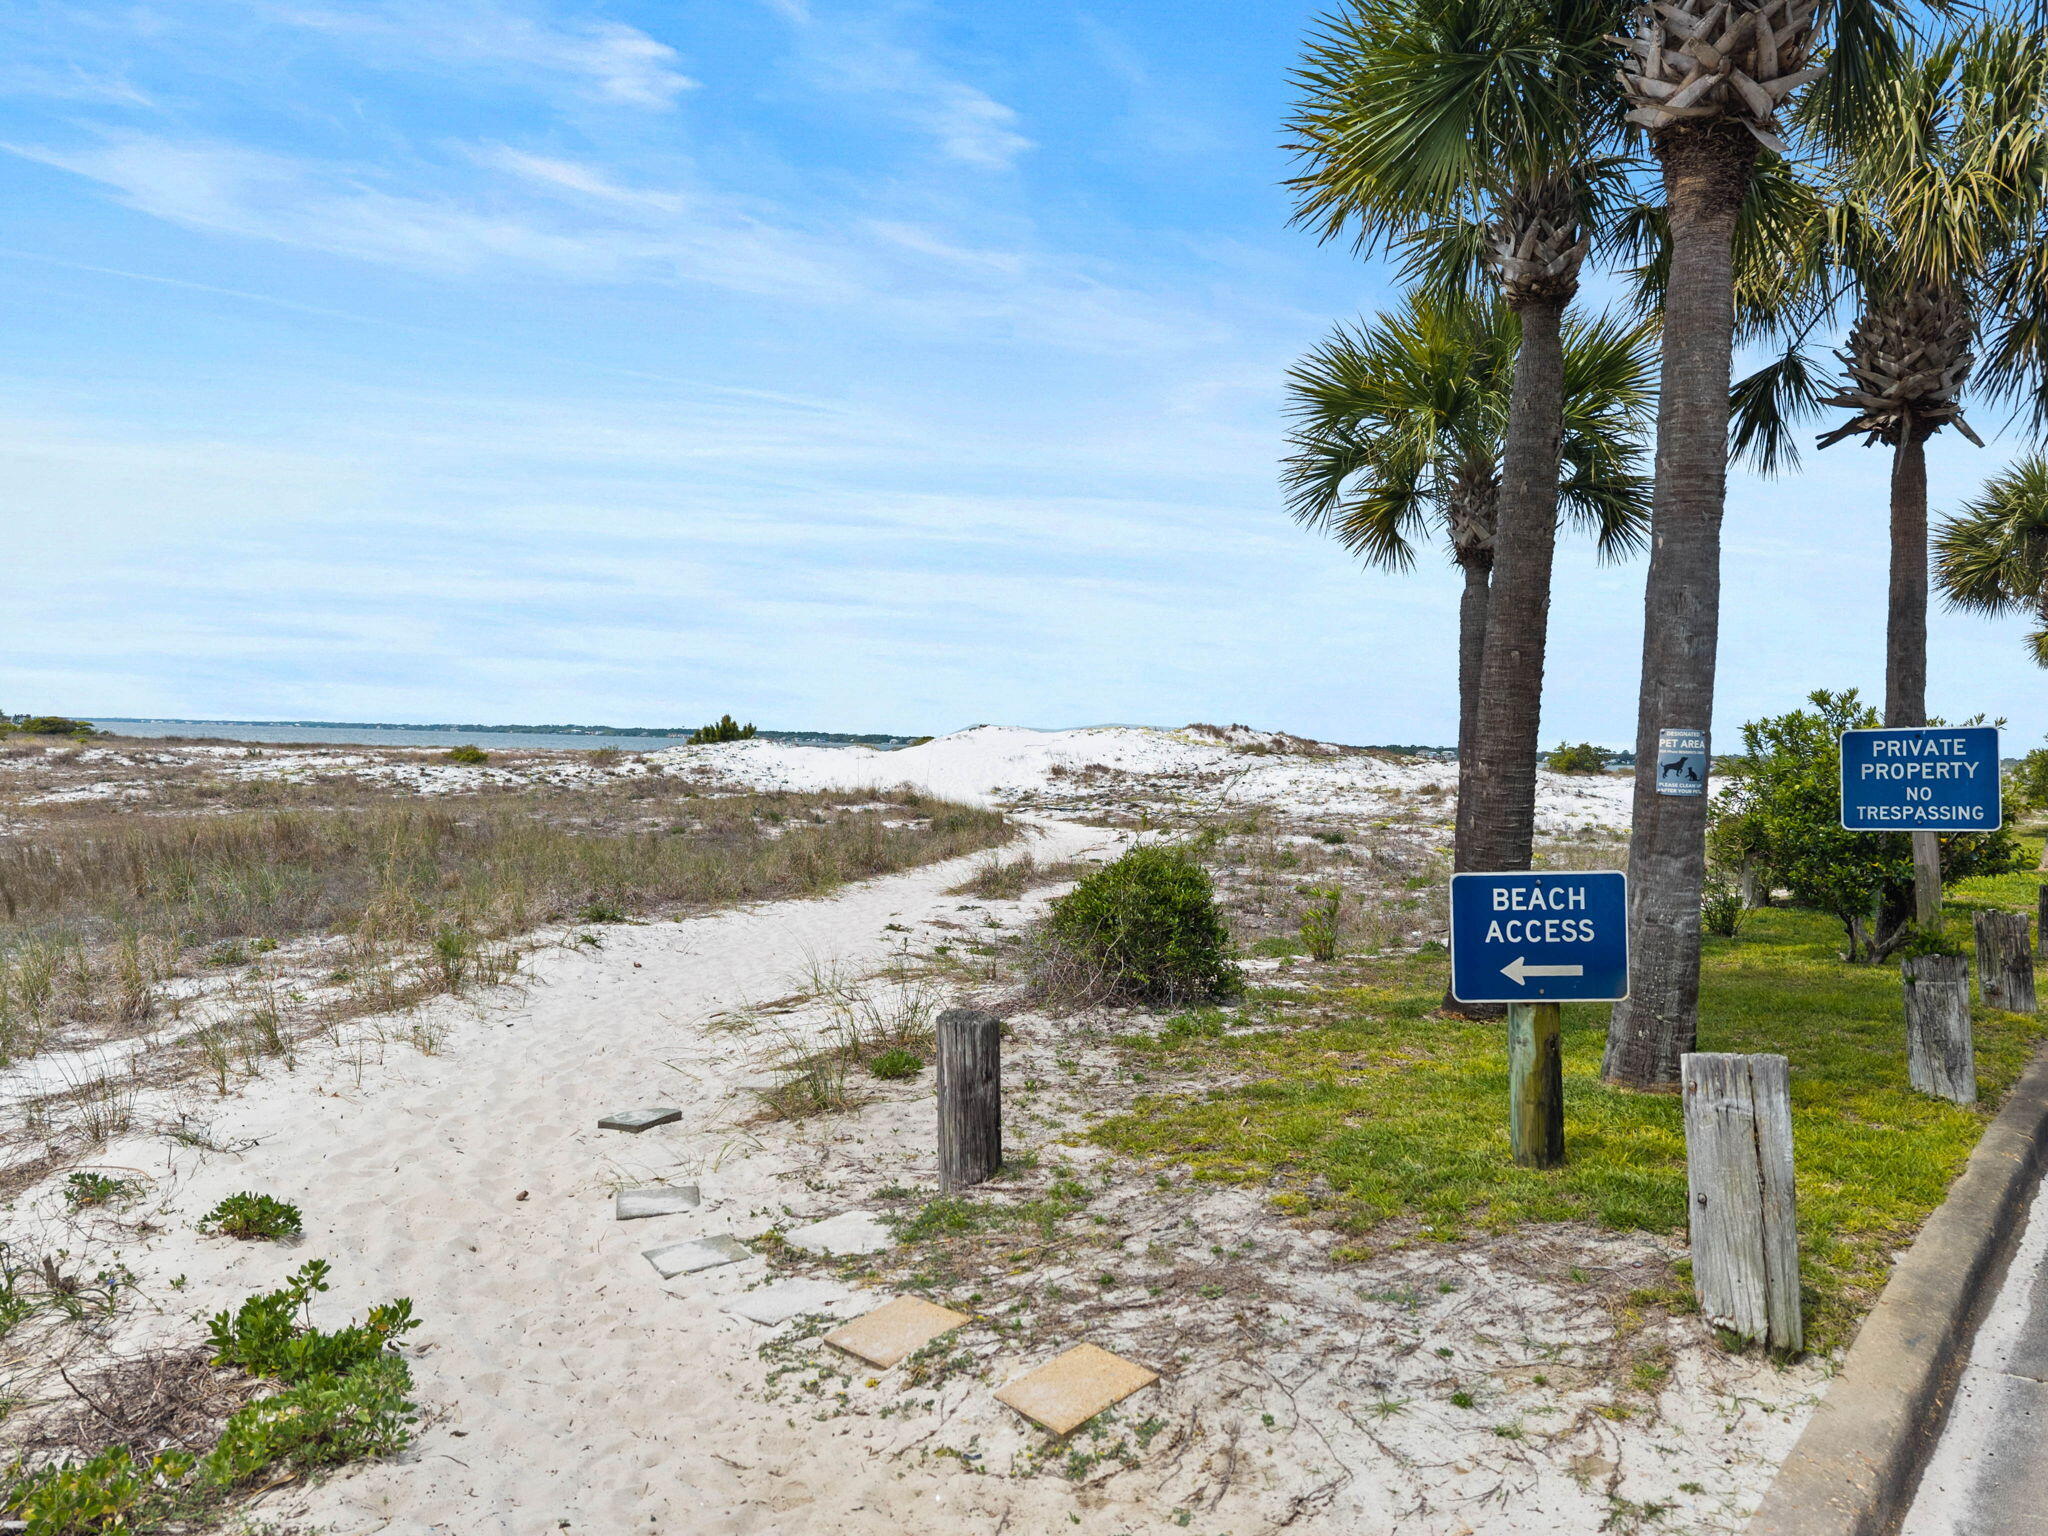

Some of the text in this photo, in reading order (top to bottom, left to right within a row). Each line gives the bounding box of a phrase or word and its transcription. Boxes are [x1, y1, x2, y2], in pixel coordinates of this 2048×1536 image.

[1659, 738, 1705, 749] PET AREA
[1872, 738, 1967, 758] PRIVATE
[1861, 761, 1979, 780] PROPERTY
[1906, 786, 1932, 801] NO
[1856, 805, 1985, 821] TRESPASSING
[1492, 887, 1586, 911] BEACH
[1485, 919, 1595, 943] ACCESS
